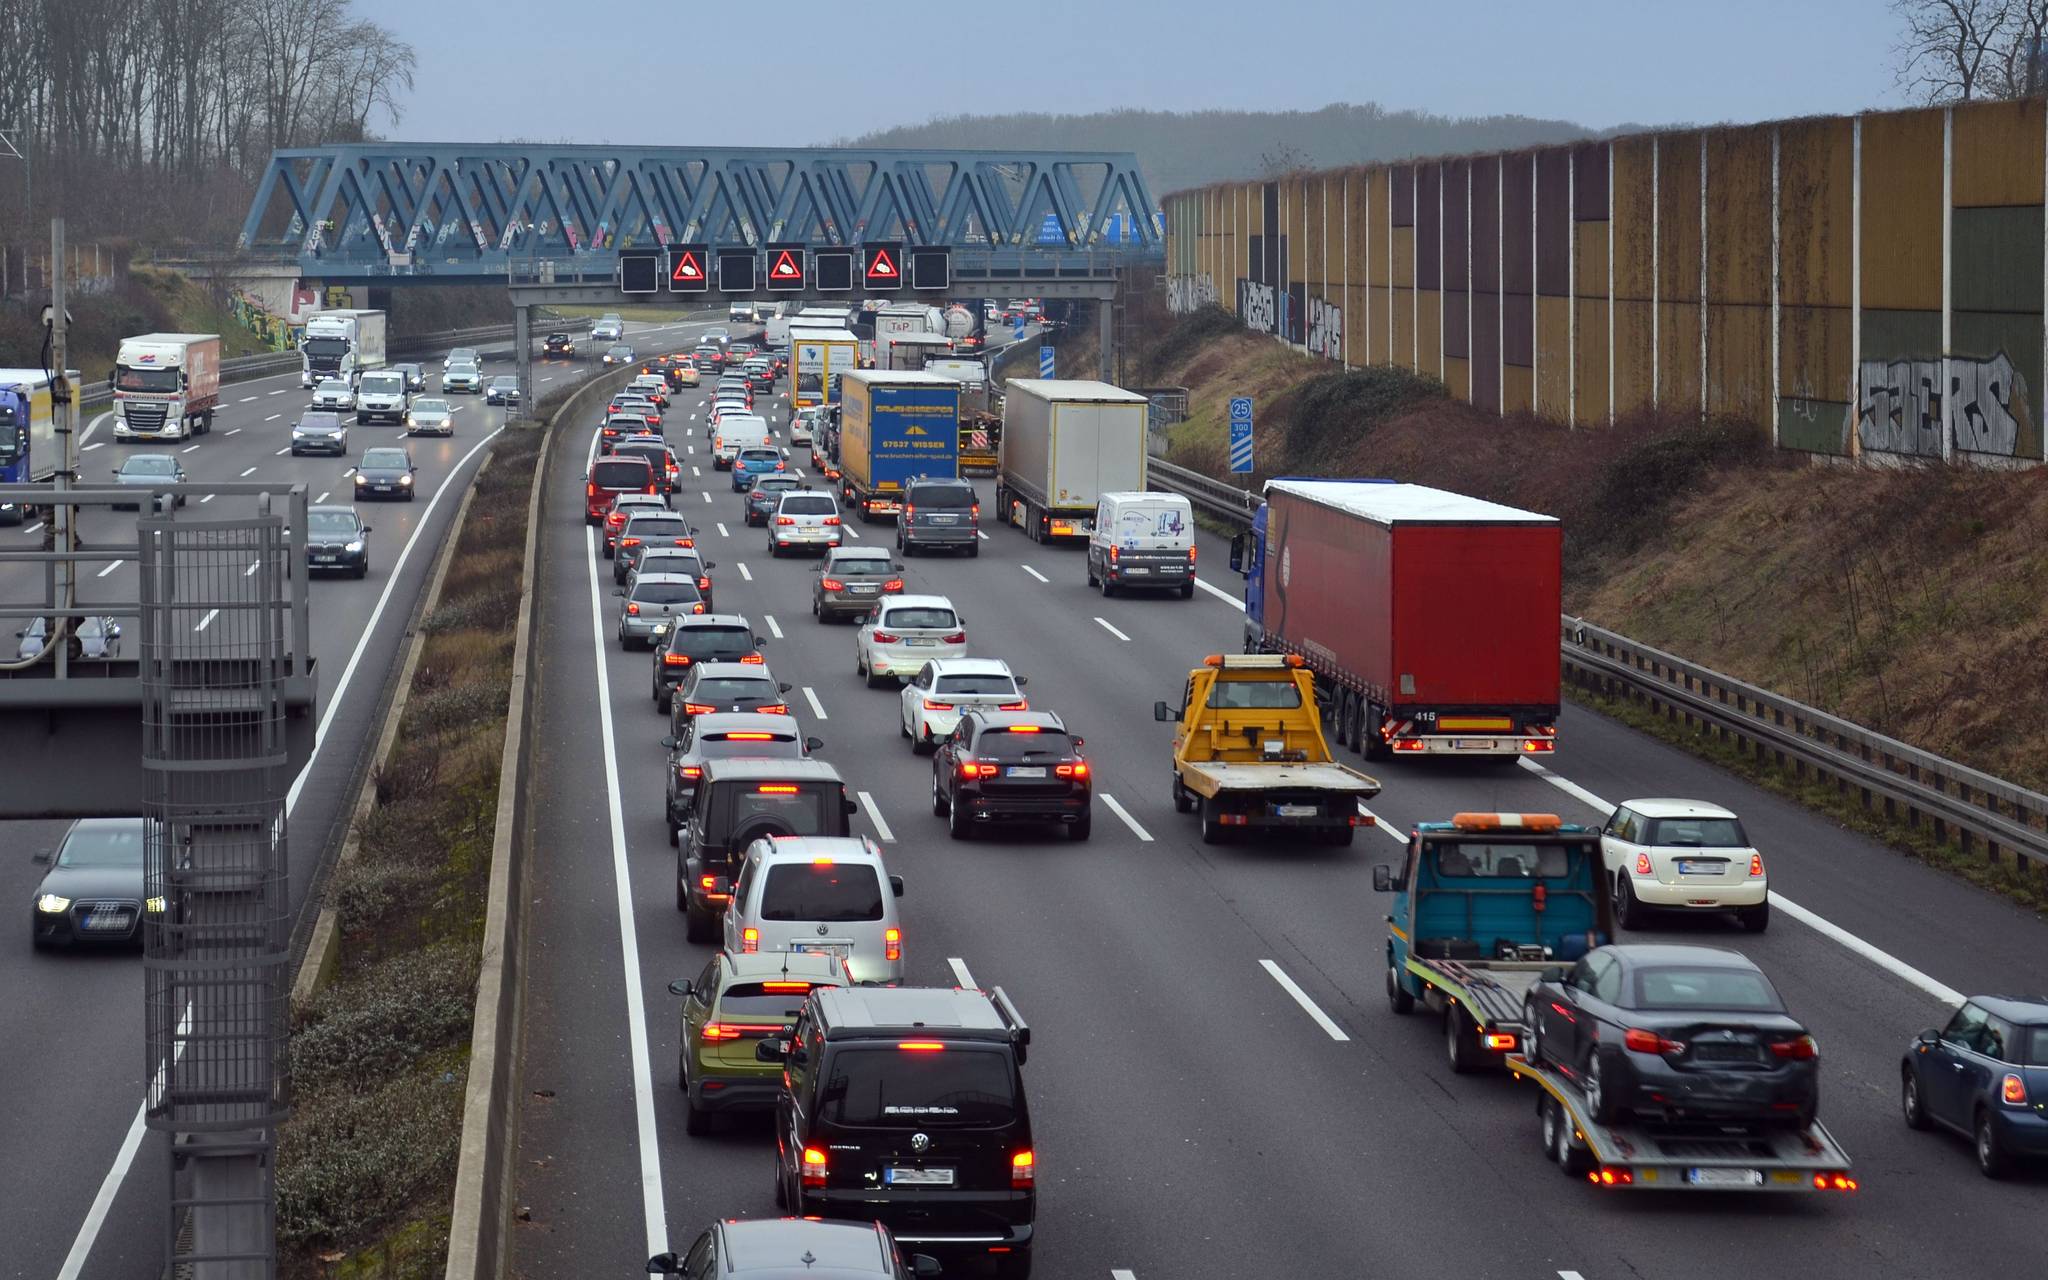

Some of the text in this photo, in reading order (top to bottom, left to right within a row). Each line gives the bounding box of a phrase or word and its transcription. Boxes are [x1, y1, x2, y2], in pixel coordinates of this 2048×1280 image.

[891, 322, 910, 331] T&P
[1234, 403, 1248, 415] 25
[1234, 423, 1249, 431] 300
[912, 441, 945, 449] WISSEN
[1415, 711, 1436, 721] 415
